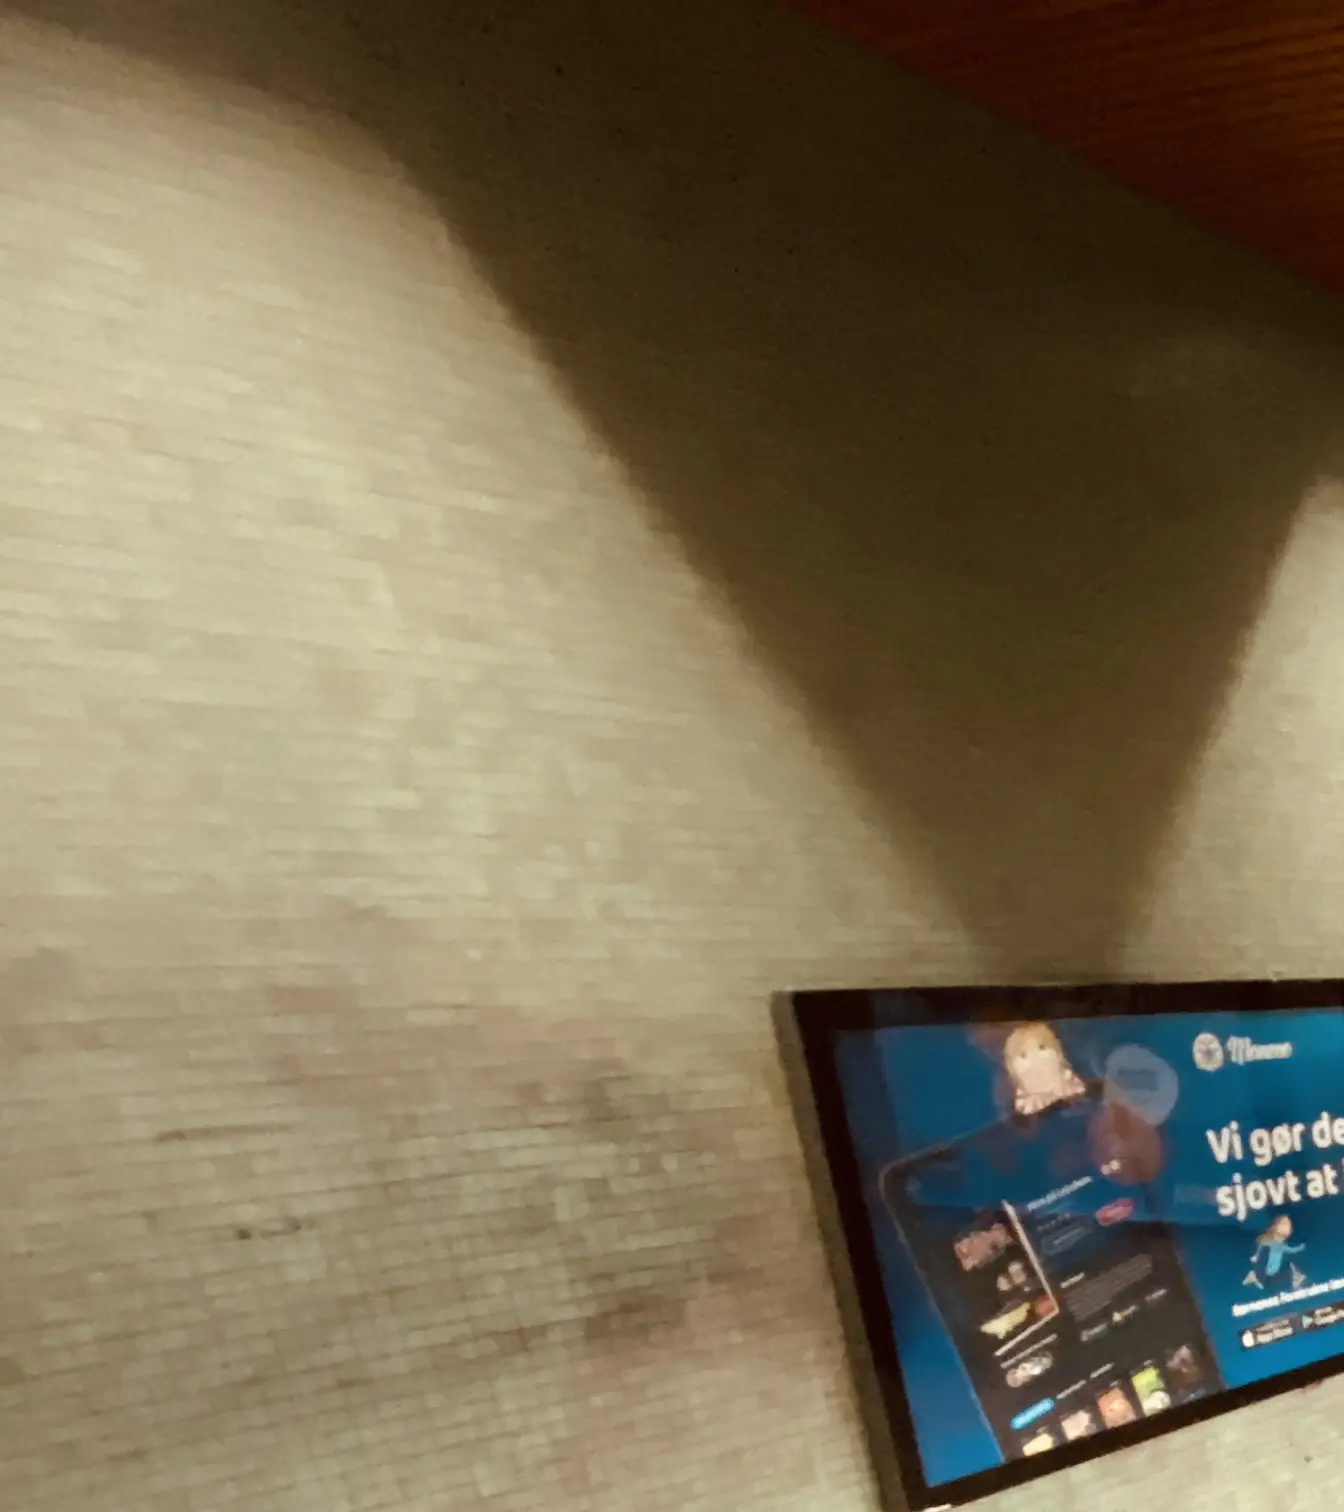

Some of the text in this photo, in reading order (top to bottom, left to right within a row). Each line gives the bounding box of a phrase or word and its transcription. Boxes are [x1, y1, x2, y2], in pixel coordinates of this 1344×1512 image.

[1206, 1120, 1244, 1164] Vi
[1249, 1122, 1305, 1167] gør
[1215, 1171, 1302, 1222] sjovt
[1305, 1163, 1339, 1199] at
